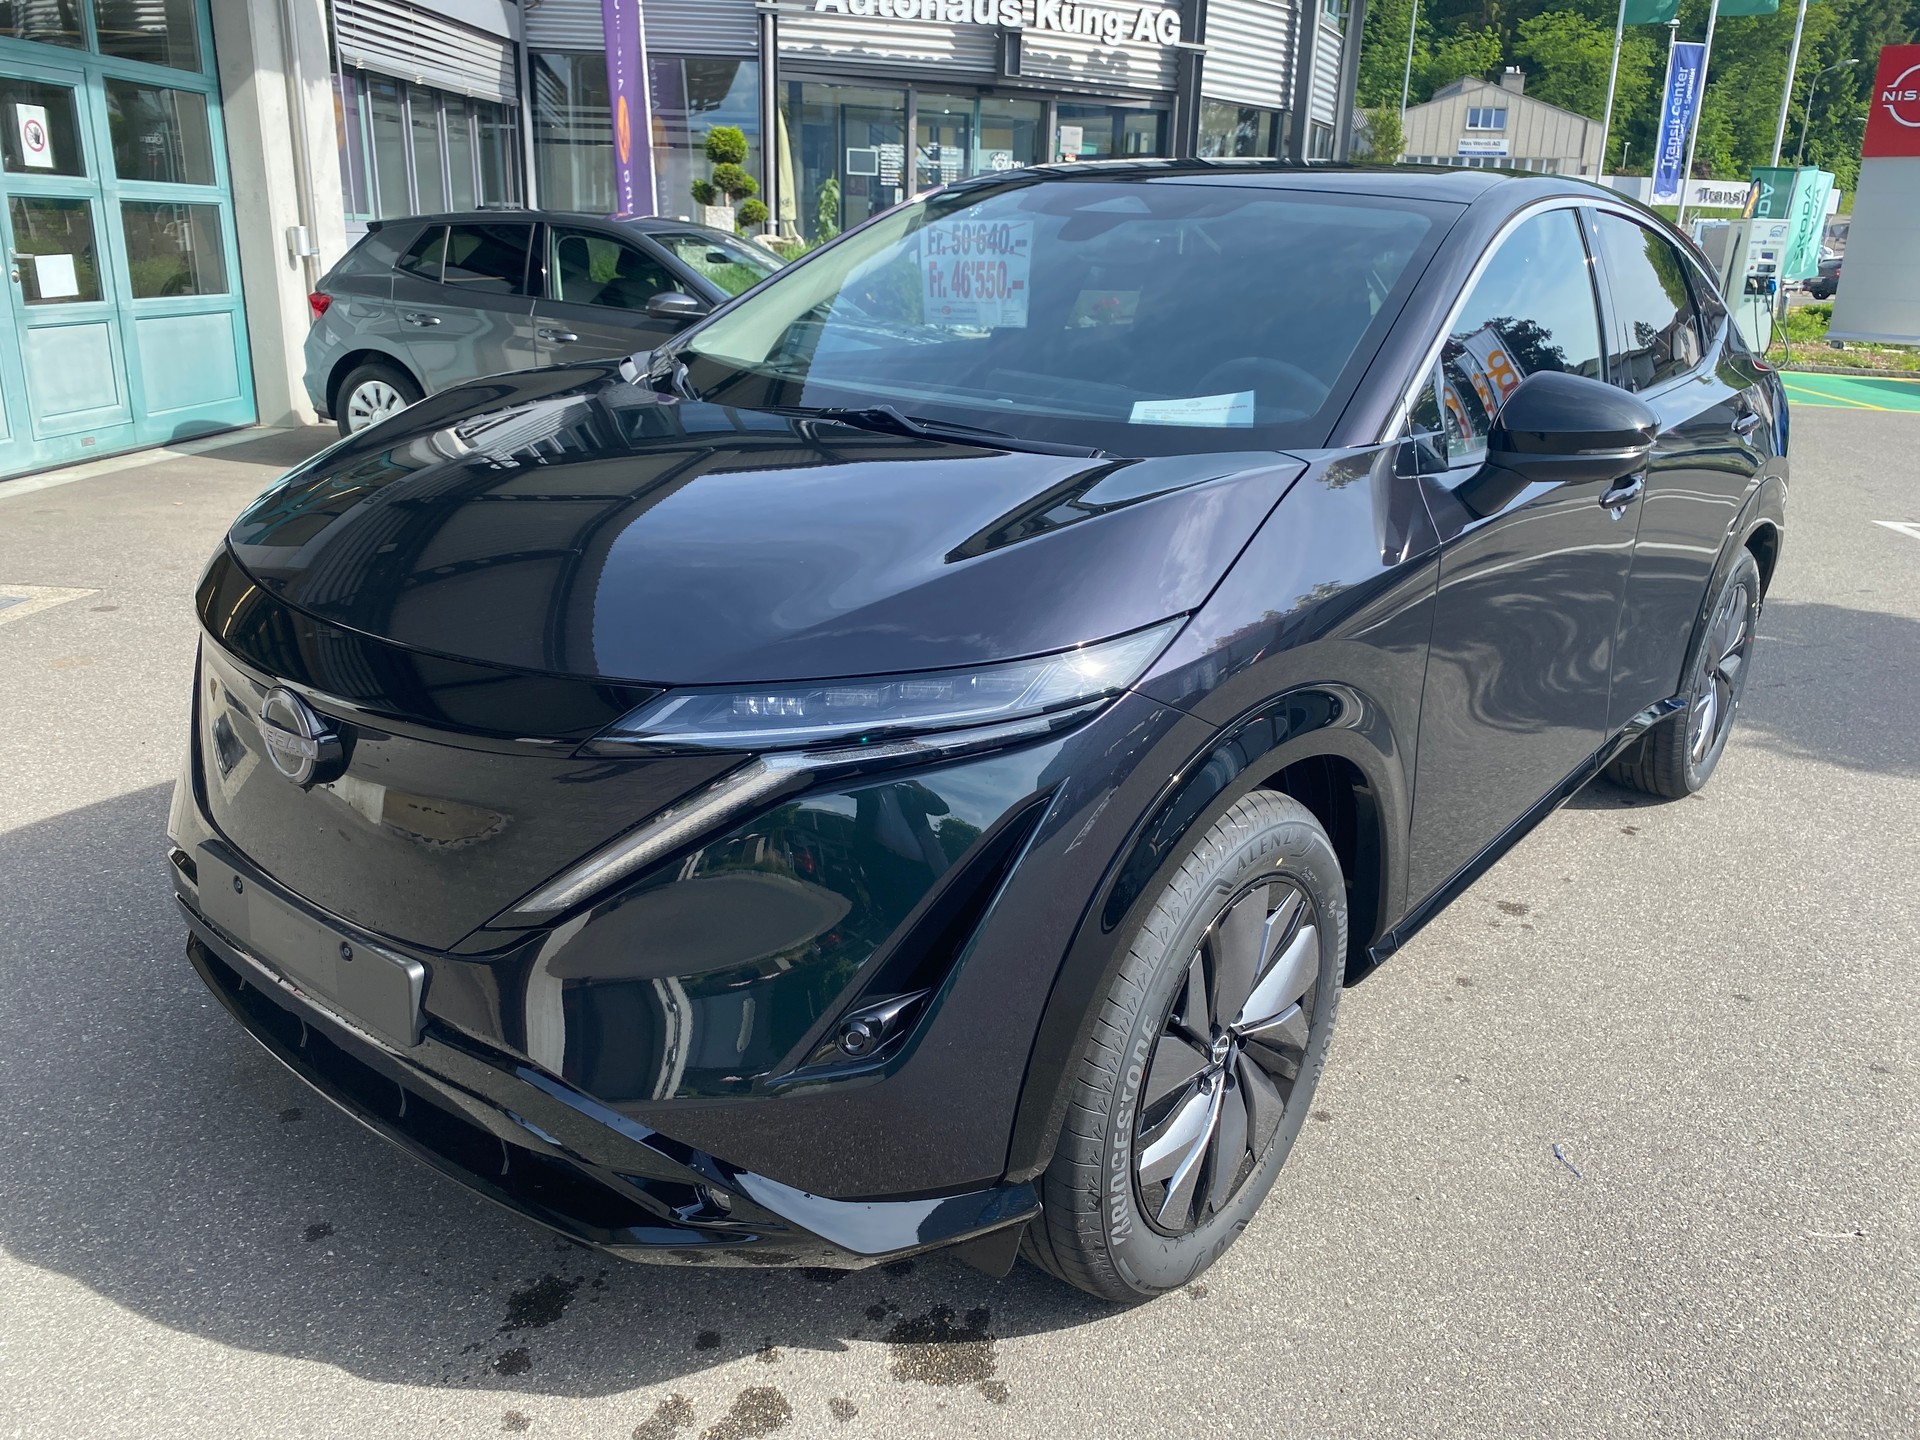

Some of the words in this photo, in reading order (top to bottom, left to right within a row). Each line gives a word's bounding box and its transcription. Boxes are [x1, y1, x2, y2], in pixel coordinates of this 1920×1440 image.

[1132, 8, 1181, 46] AG
[1882, 89, 1920, 102] NIS
[1660, 117, 1681, 169] Transit
[927, 225, 946, 256] Fr.
[928, 261, 947, 298] Fr.
[1235, 827, 1304, 879] ALENZA
[1110, 1014, 1155, 1247] BRIDGESTONE
